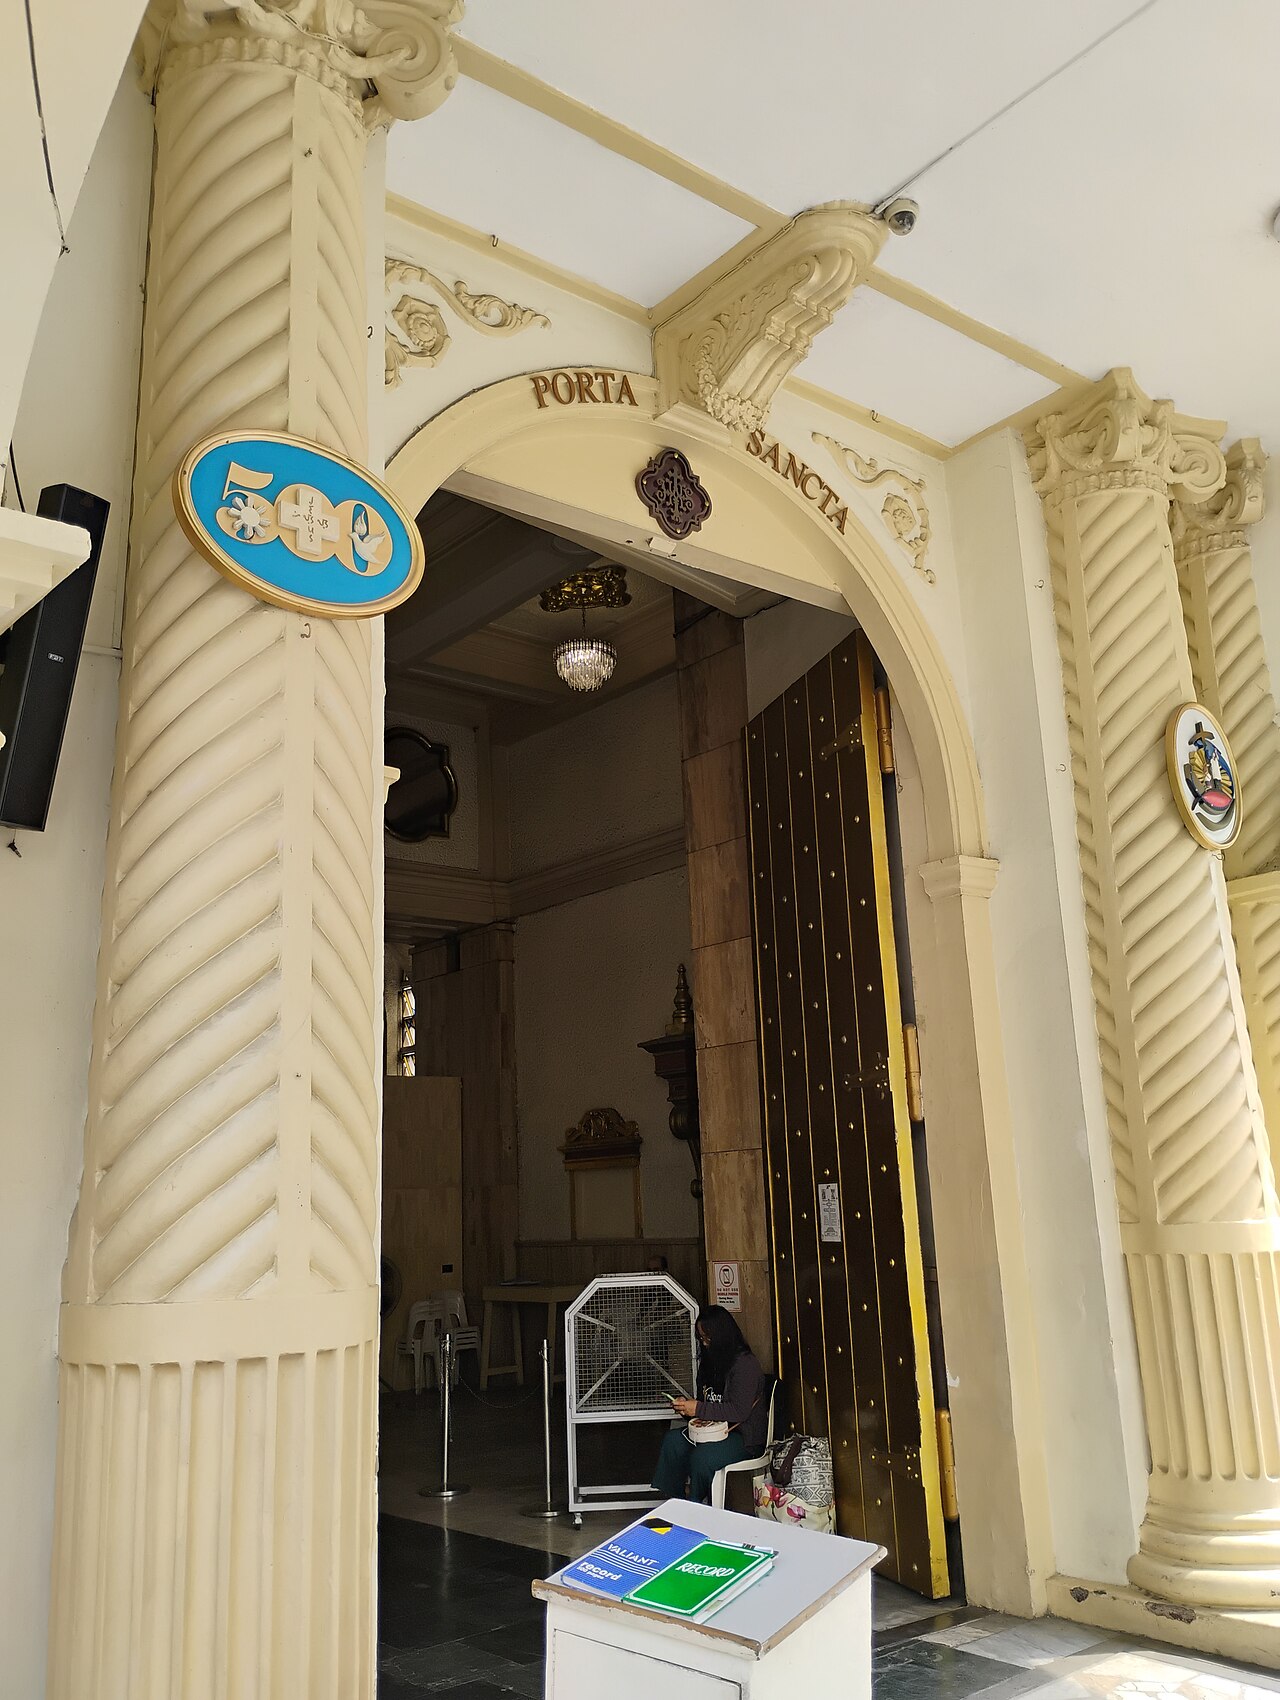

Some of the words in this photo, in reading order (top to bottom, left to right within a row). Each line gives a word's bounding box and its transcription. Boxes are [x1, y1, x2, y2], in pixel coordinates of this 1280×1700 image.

[529, 372, 639, 409] PORTA
[746, 428, 849, 535] SANCTA
[607, 1543, 659, 1566] VALIANT
[580, 1561, 622, 1581] record
[675, 1562, 736, 1577] RECORD
